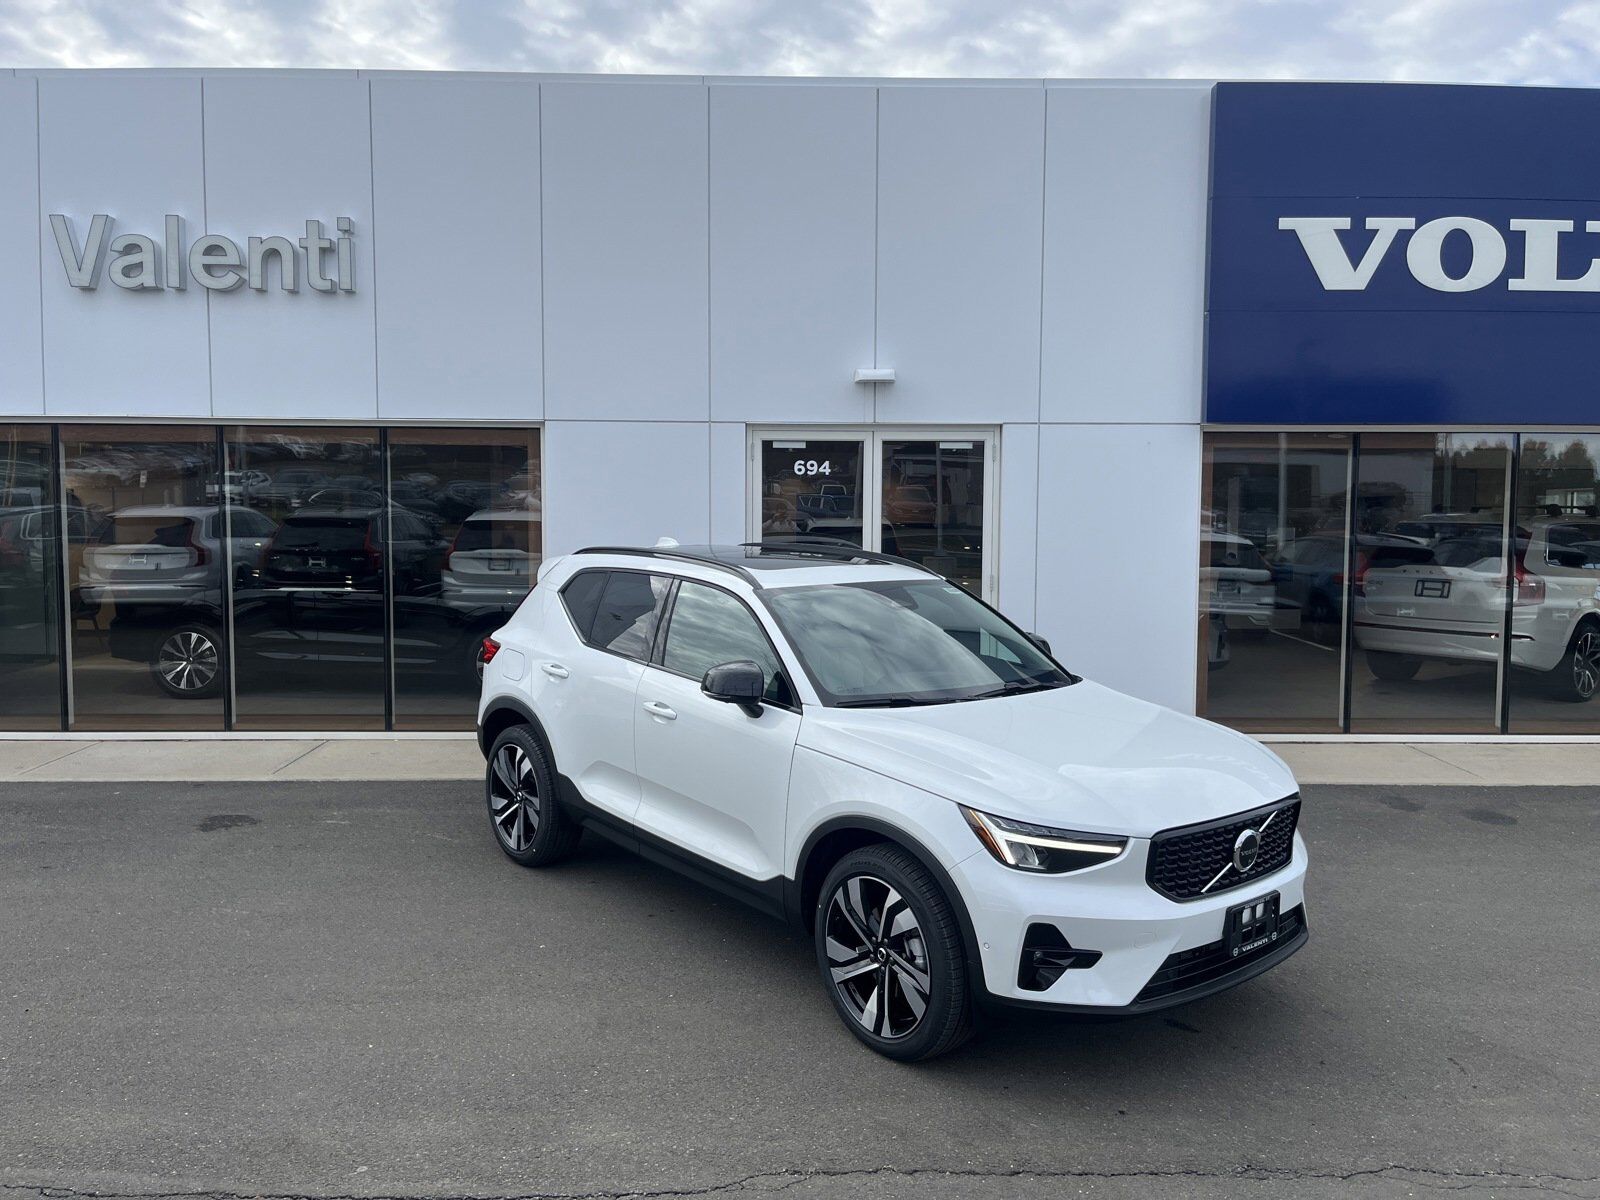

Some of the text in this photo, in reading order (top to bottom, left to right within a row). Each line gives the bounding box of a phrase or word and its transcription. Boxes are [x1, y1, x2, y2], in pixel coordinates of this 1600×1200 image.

[49, 214, 355, 292] Valenti
[1278, 216, 1600, 292] VOL
[794, 460, 831, 475] 694
[1242, 938, 1268, 951] VALENTI
